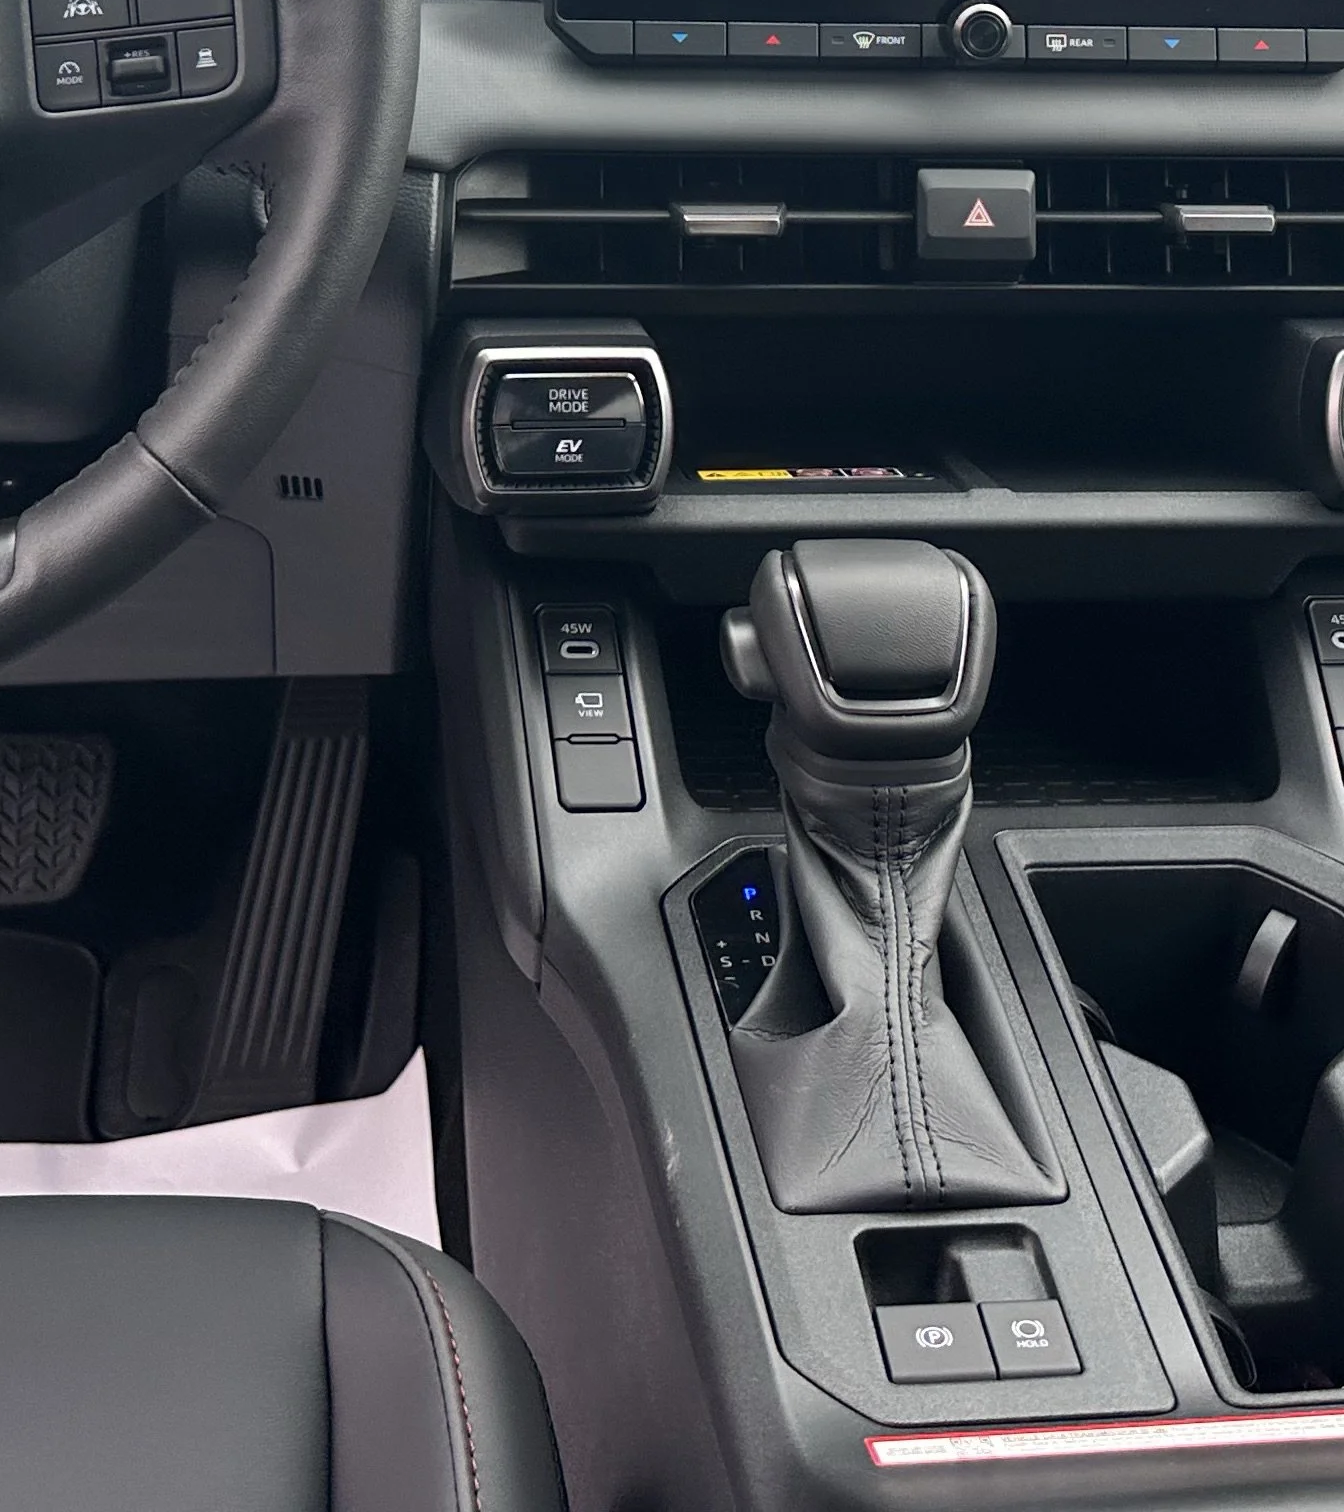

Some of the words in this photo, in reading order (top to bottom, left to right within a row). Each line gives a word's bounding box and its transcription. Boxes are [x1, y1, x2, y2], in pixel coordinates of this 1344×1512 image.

[876, 35, 906, 46] FRONT
[1069, 38, 1094, 48] REAR
[56, 75, 84, 86] MODE
[549, 388, 590, 400] DRIVE
[549, 401, 589, 413] MODE
[556, 439, 583, 453] EV
[555, 453, 584, 463] MODE
[560, 623, 593, 634] 45W
[578, 710, 605, 718] VIEW
[743, 887, 757, 901] P
[750, 909, 764, 921] R
[755, 932, 771, 944] N
[720, 955, 733, 968] S
[761, 955, 776, 967] D
[1016, 1338, 1049, 1349] HOLD
